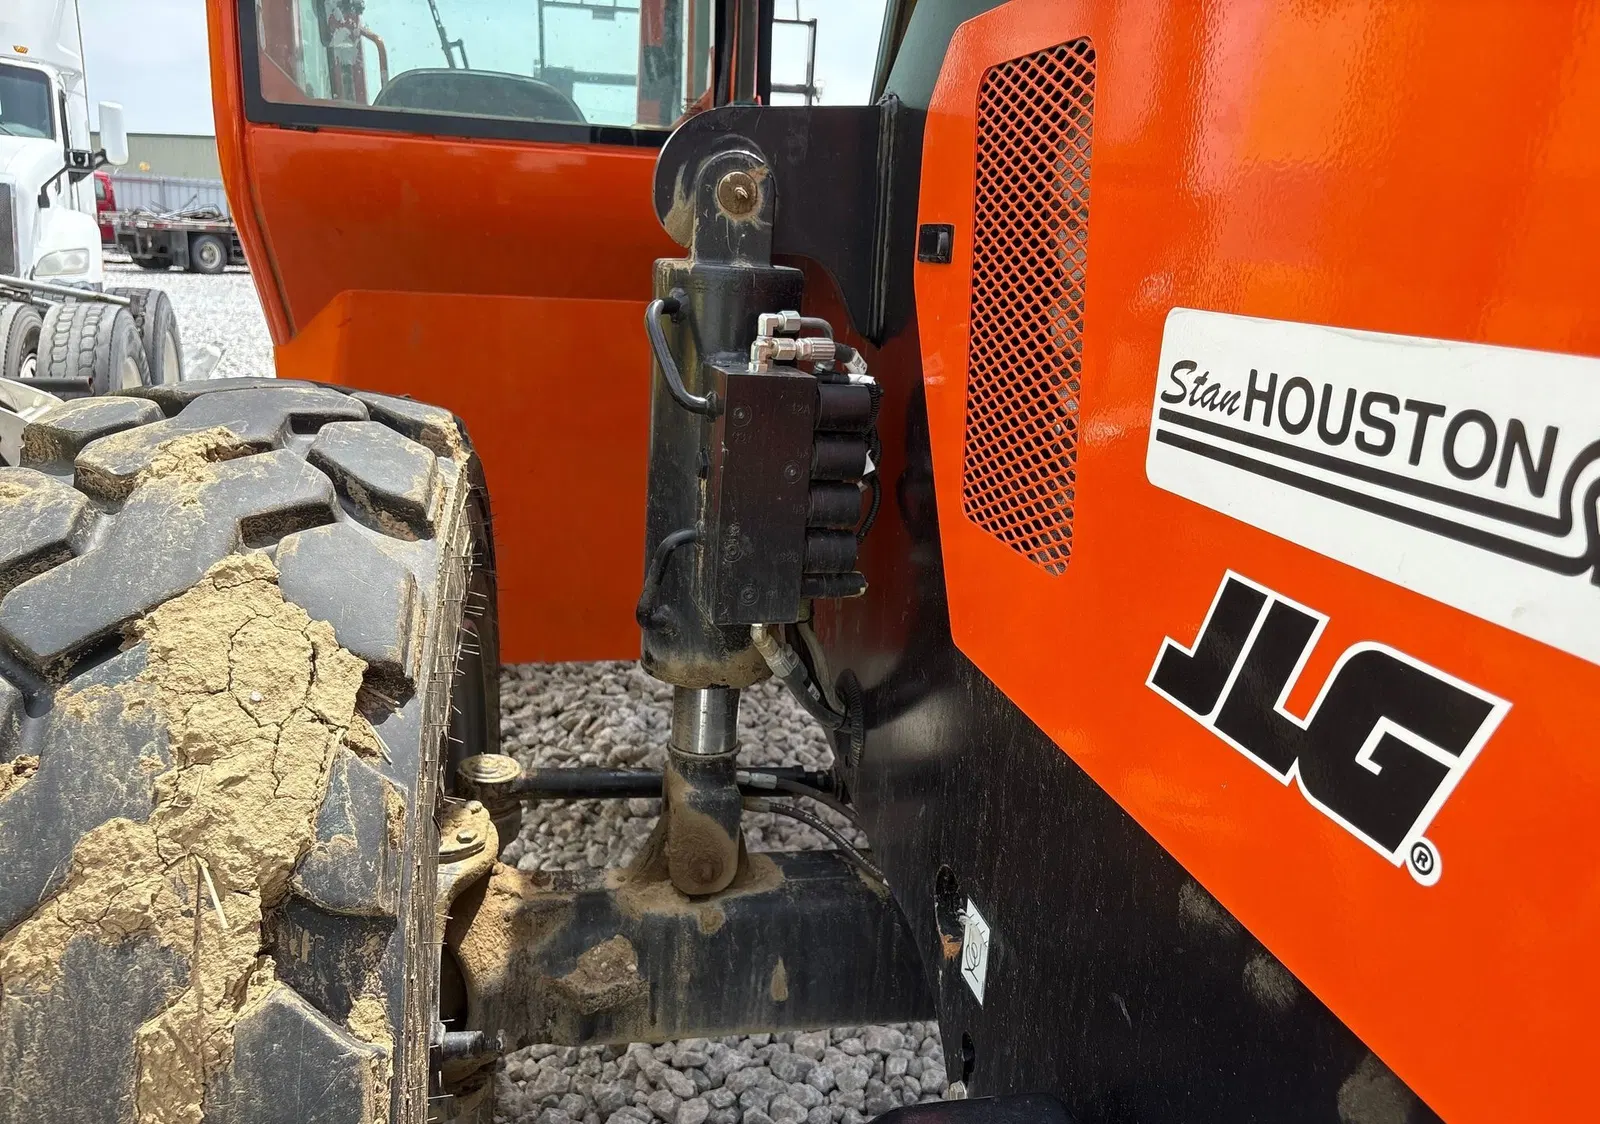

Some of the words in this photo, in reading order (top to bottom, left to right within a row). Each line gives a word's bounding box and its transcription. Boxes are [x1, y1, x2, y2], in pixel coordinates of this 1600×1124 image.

[1160, 360, 1241, 414] Stan
[1243, 368, 1559, 498] HOUSTON
[1147, 570, 1511, 866] JLG
